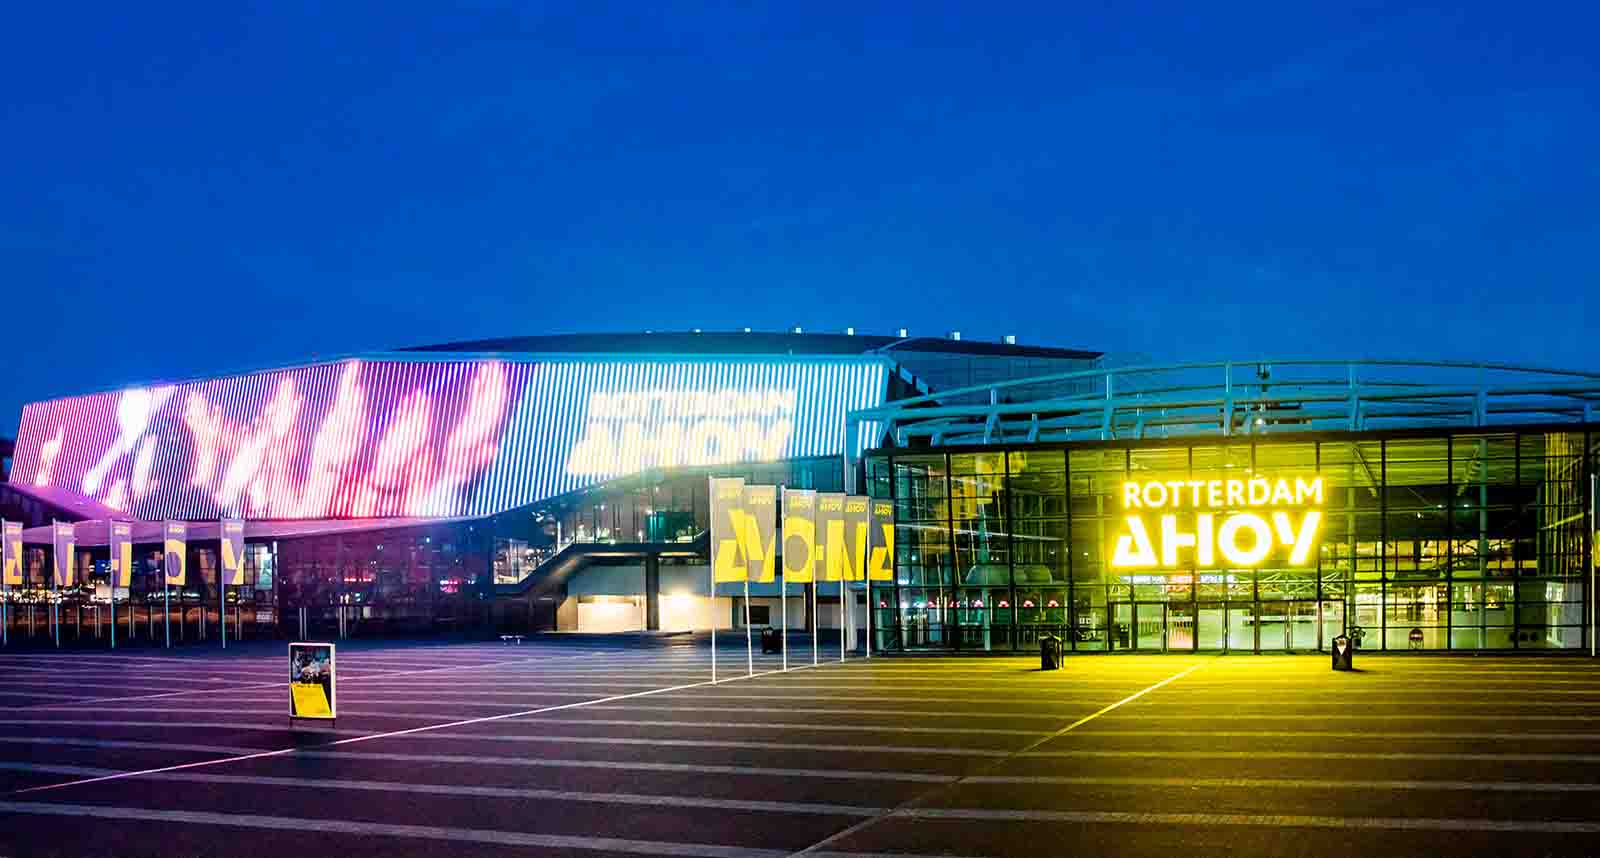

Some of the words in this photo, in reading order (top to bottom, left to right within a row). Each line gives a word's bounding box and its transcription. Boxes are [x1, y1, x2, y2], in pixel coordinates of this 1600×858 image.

[567, 419, 792, 474] AHOY
[1123, 477, 1324, 508] ROTTERDAM
[1111, 511, 1322, 567] AHOY
